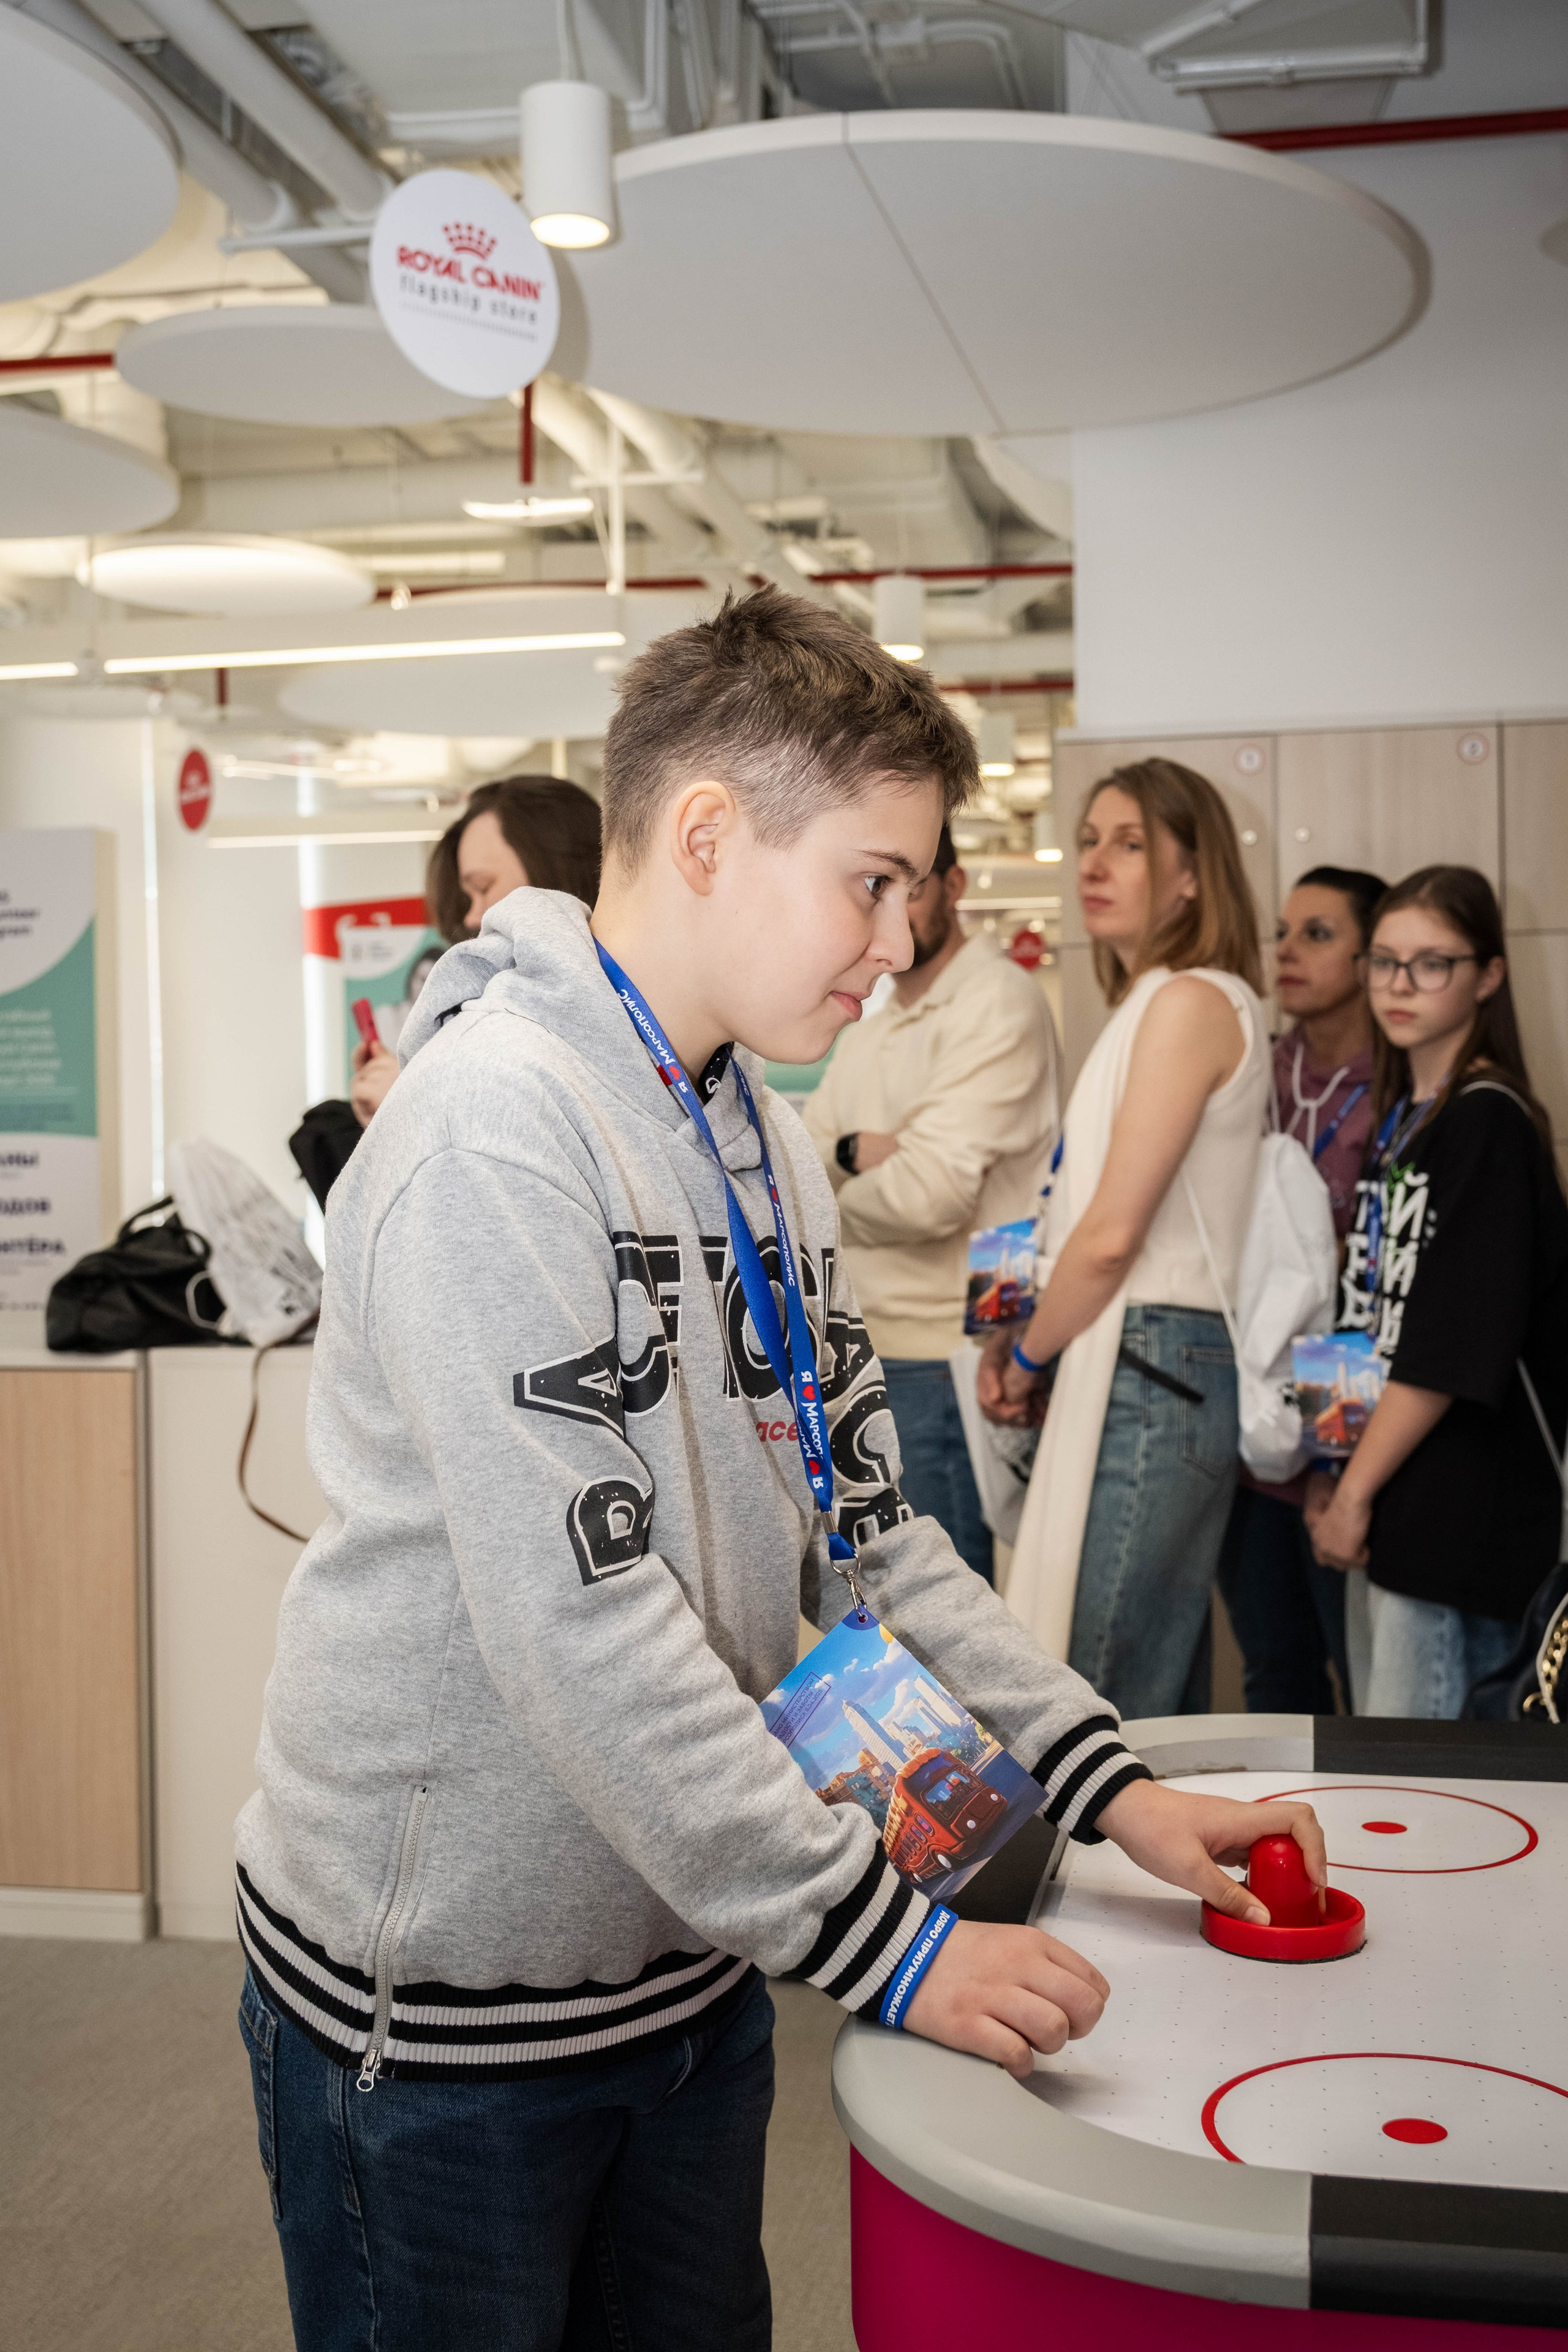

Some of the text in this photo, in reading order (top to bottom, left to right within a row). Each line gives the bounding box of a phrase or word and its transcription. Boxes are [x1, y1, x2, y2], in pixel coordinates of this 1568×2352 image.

[397, 246, 542, 303] ROYAL CANIN
[677, 1080, 689, 1094] Я
[767, 1174, 774, 1186] Я
[801, 1370, 813, 1382] Я
[812, 1476, 824, 1490] Я
[782, 1711, 806, 1744] РСОПОЛИСА
[886, 1909, 951, 2024] ДОБРО ПРИУМНОЖАЕТ
